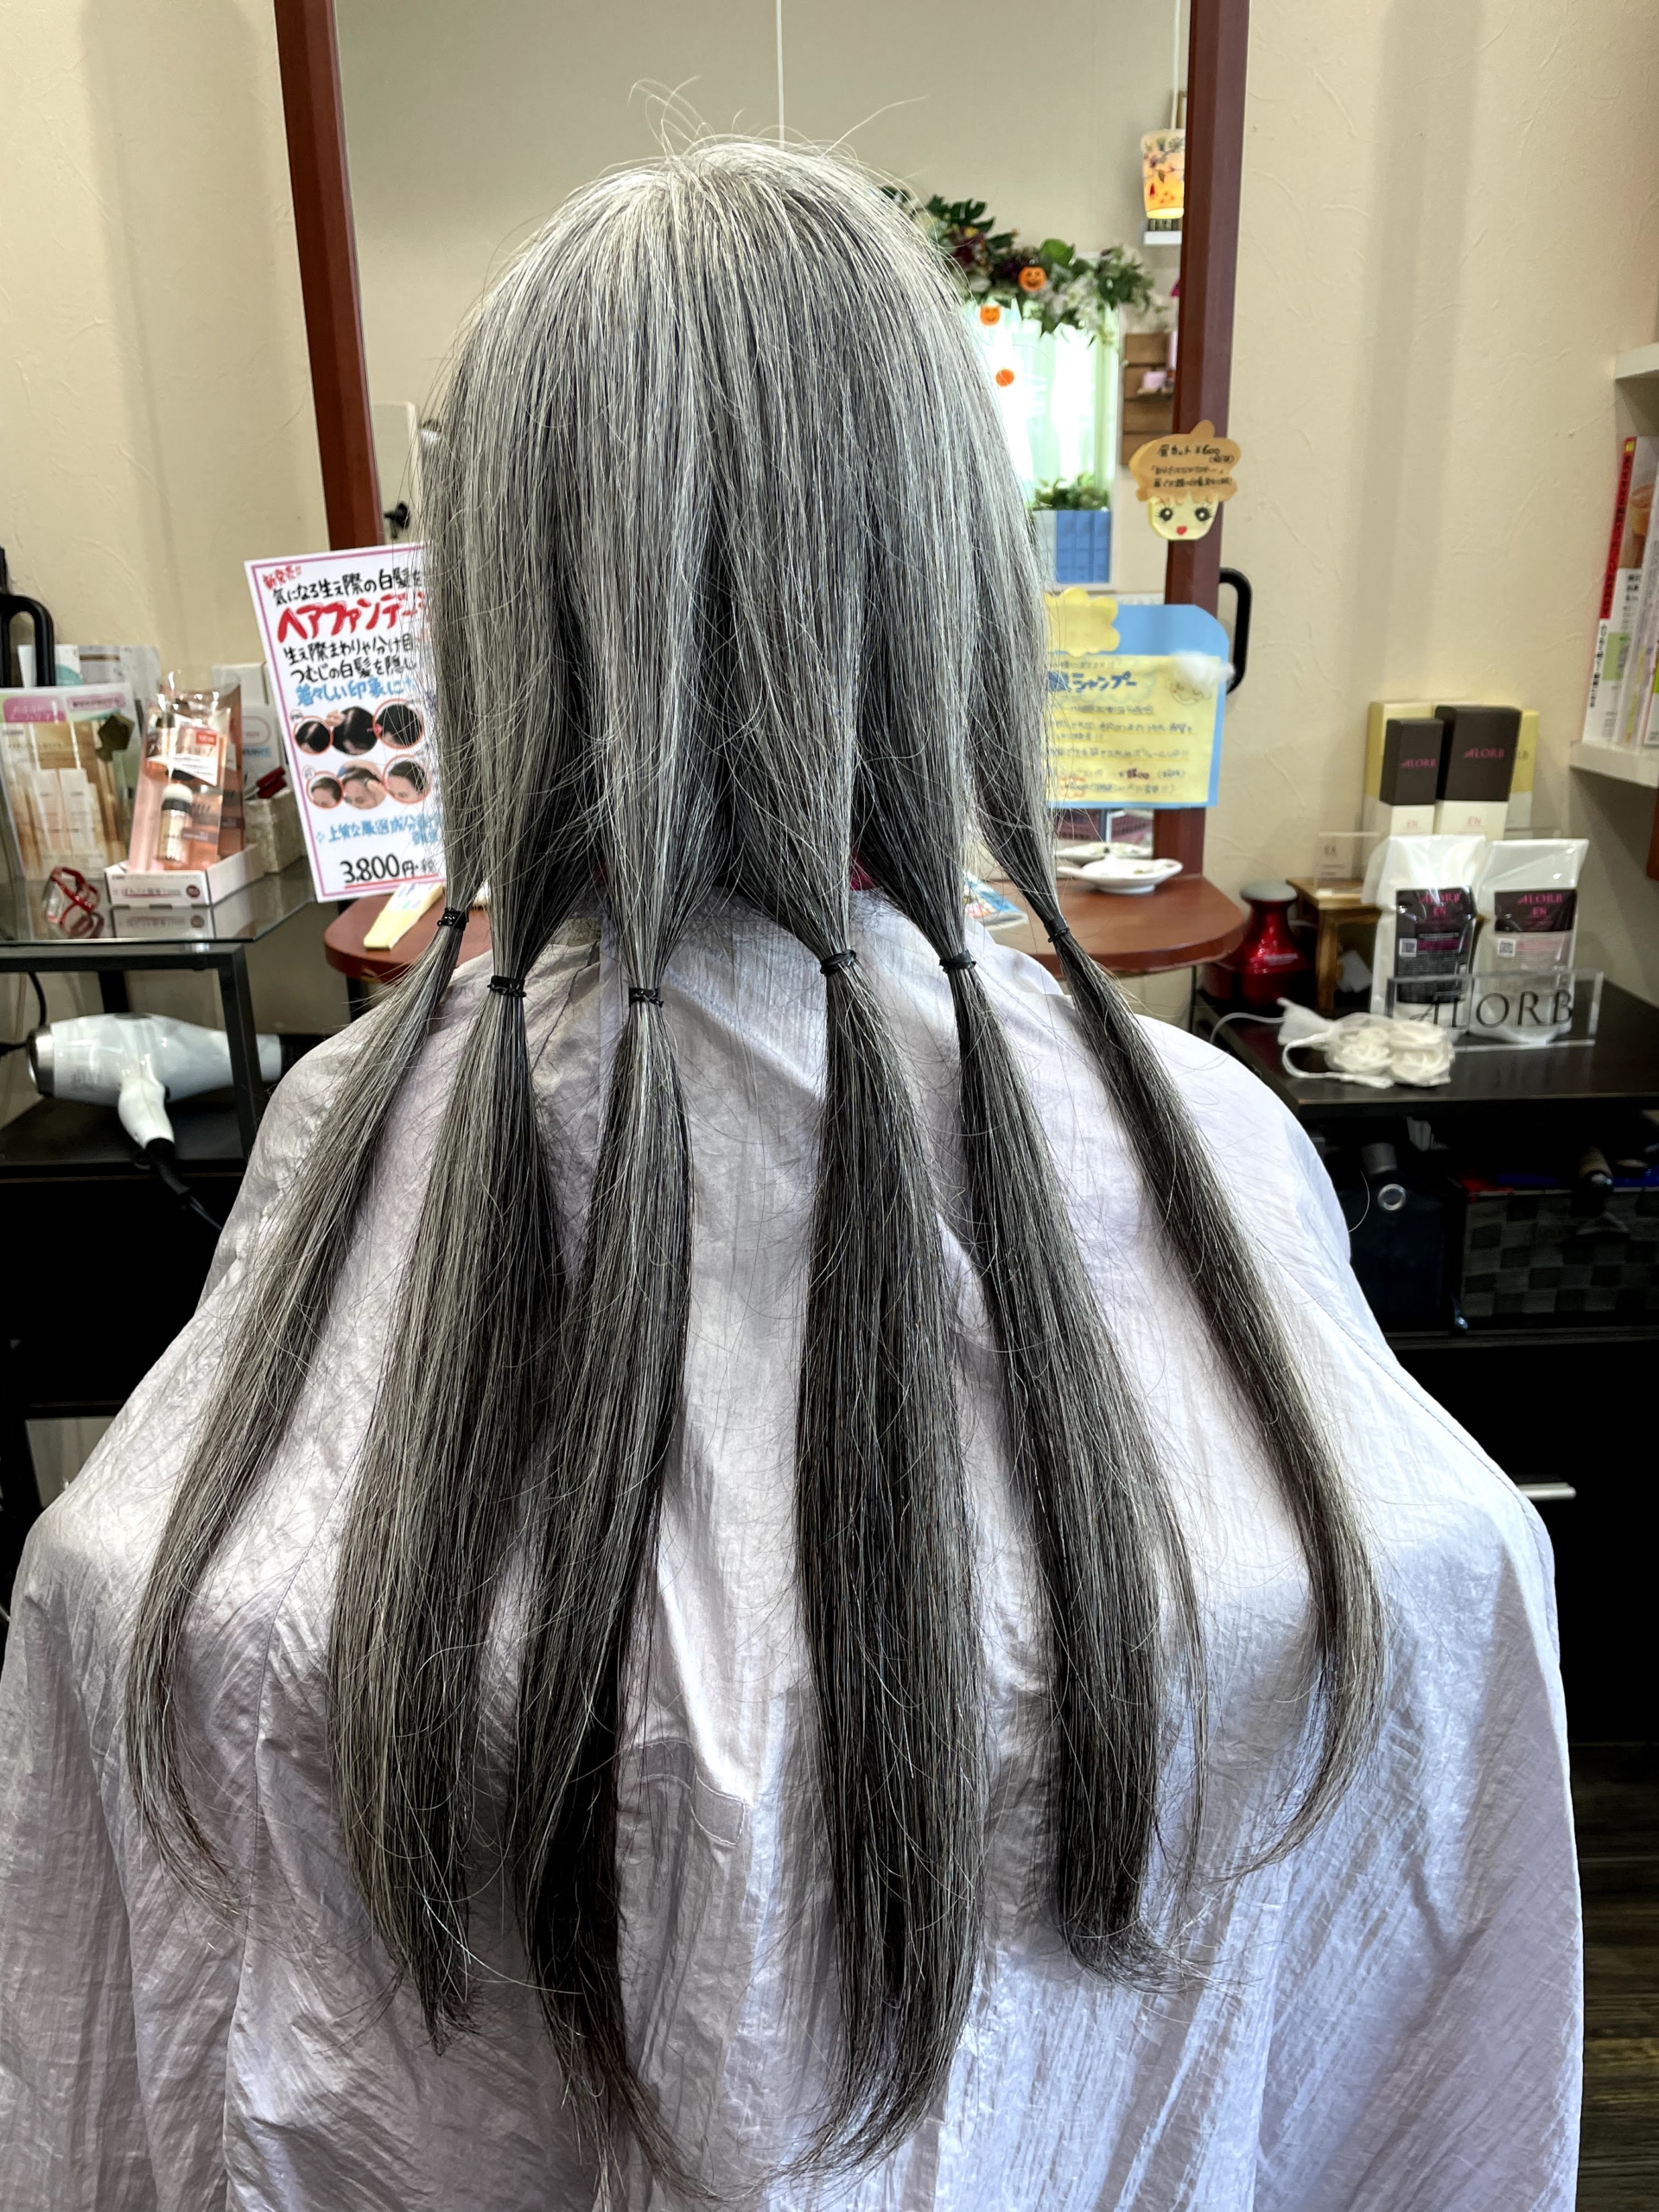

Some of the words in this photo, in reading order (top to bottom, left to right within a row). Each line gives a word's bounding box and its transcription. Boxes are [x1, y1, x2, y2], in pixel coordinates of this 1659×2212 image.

[1464, 747, 1505, 759] ALORB
[1401, 758, 1436, 769] ALORB
[1517, 893, 1563, 905] ALORB
[1433, 906, 1446, 916] EN
[1532, 906, 1547, 916] EN
[1409, 988, 1573, 1028] ALORB
